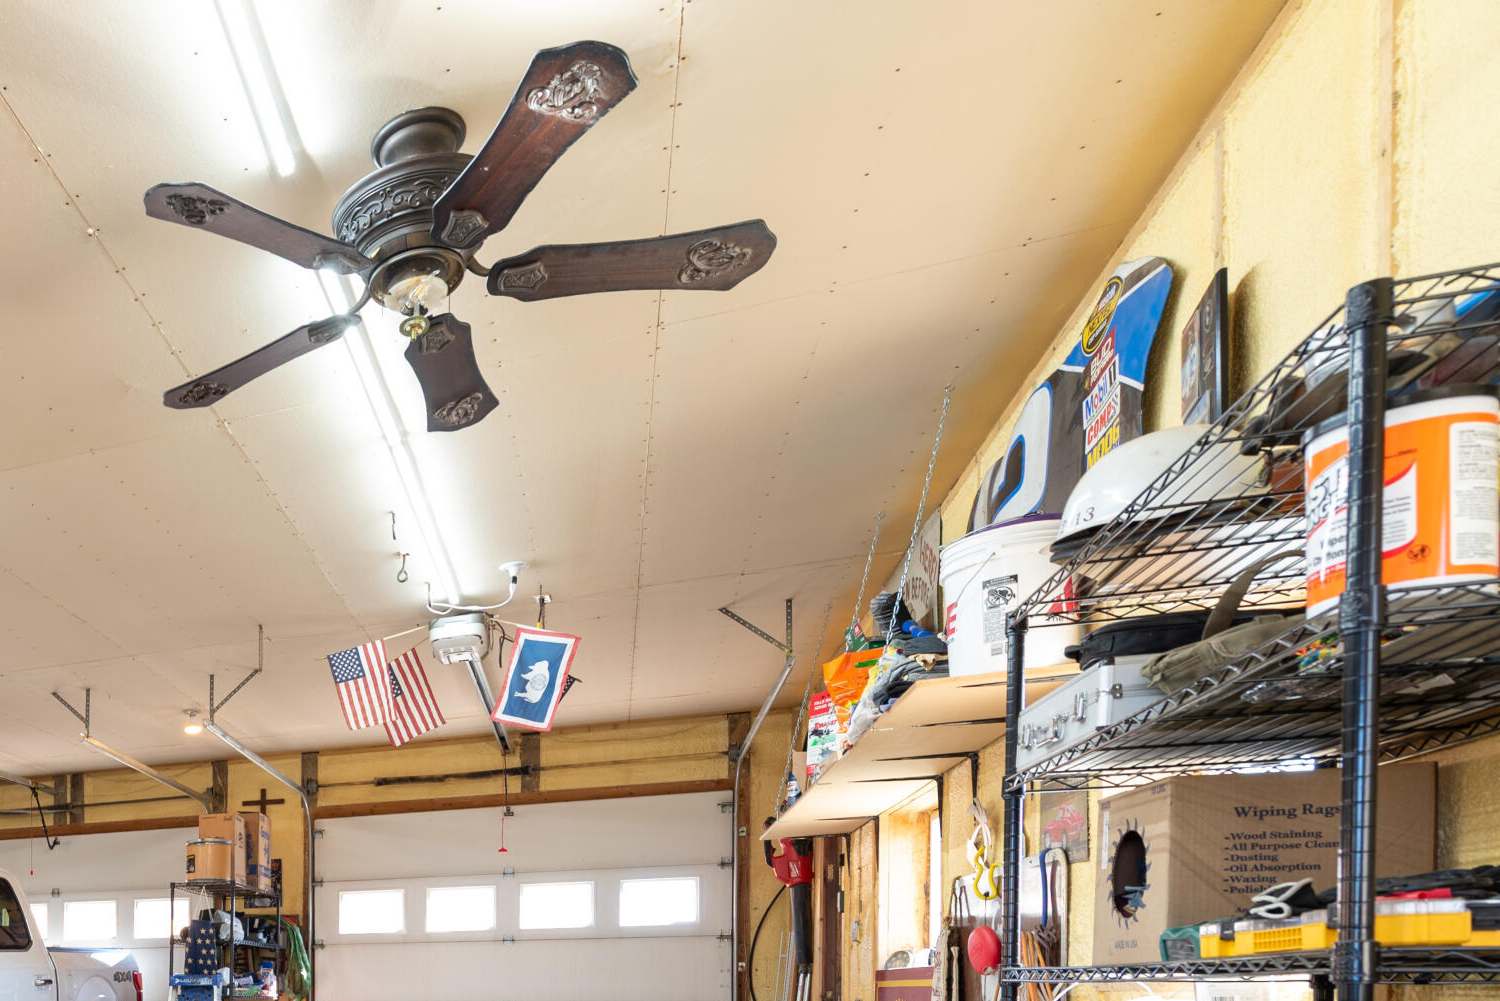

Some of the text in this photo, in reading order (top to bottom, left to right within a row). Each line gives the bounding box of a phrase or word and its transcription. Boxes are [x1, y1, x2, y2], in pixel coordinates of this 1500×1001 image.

[1233, 805, 1298, 821] Wiping
[1269, 829, 1323, 840] Staining
[1251, 841, 1302, 852] Purpose
[1251, 862, 1322, 873] Absorption
